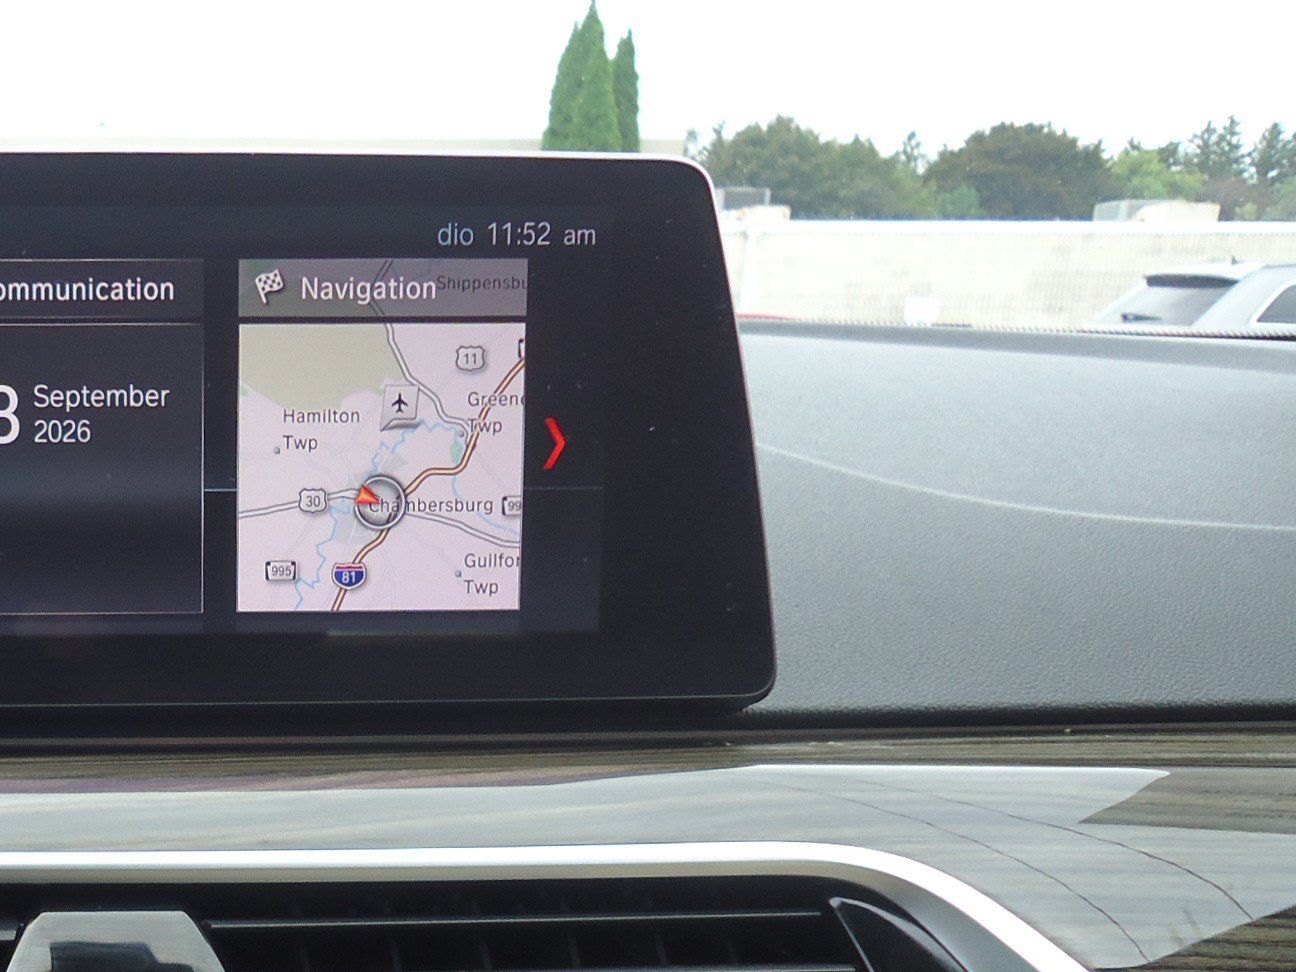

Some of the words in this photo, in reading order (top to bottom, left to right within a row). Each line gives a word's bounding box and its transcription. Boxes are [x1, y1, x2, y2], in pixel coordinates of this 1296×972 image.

[437, 224, 474, 246] dio
[487, 222, 551, 247] 11:52
[563, 228, 596, 246] am
[301, 276, 436, 306] Navigation
[464, 352, 477, 365] 11
[33, 384, 171, 412] September
[283, 409, 360, 426] Hamilton
[34, 419, 91, 444] 2026
[467, 418, 503, 436] Twp
[283, 435, 318, 453] Twp
[305, 495, 322, 508] 30
[368, 497, 494, 515] Chambersburg
[271, 565, 292, 577] 995
[341, 570, 356, 584] 81
[464, 579, 499, 597] Twp
